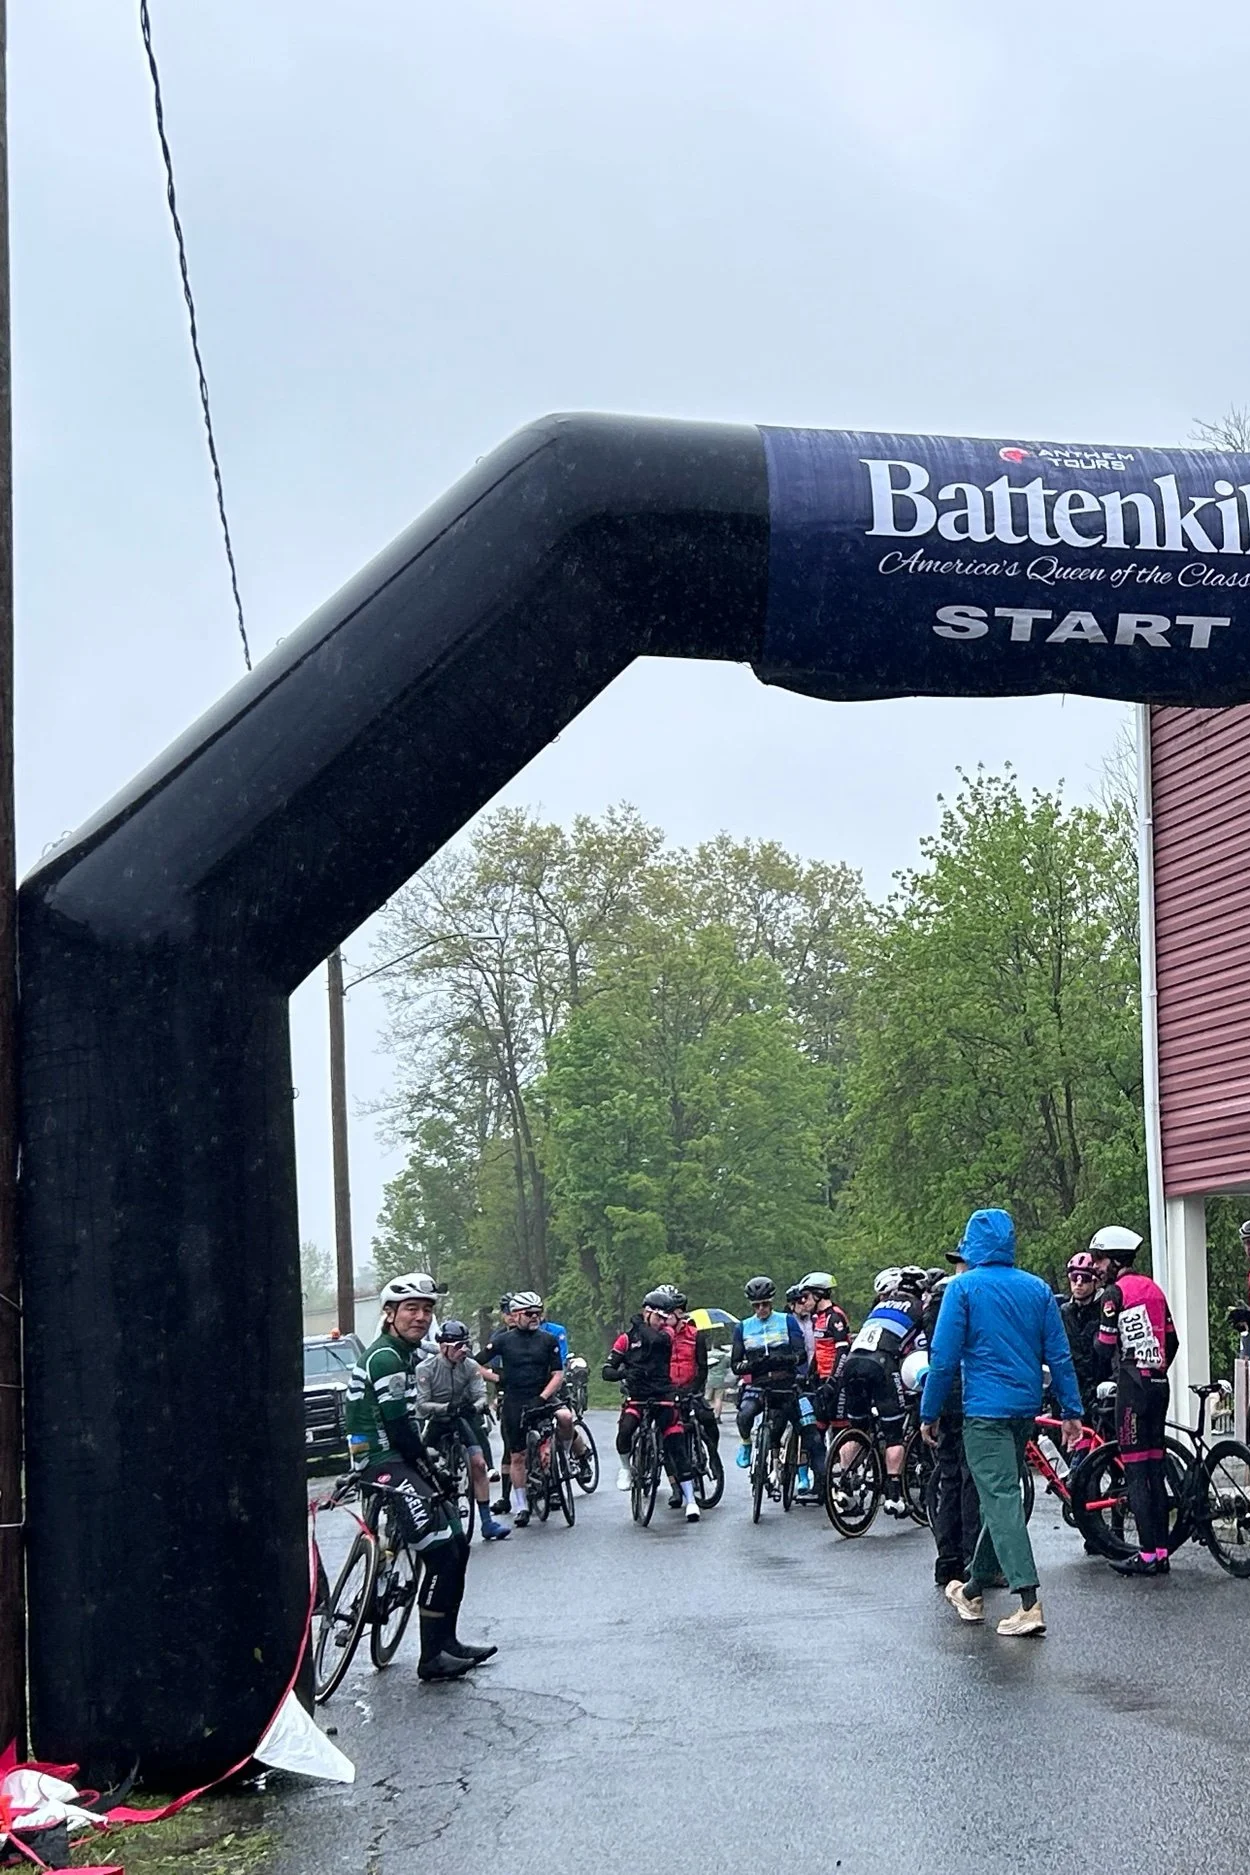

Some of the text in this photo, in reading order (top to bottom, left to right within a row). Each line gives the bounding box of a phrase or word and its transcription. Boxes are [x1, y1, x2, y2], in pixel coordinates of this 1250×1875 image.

[1038, 449, 1135, 462] ANTHEM
[1047, 457, 1126, 471] TOURS
[878, 547, 1022, 577] America's
[1026, 555, 1106, 586] Queen
[1110, 563, 1136, 589] of
[1136, 566, 1173, 586] the
[932, 604, 1231, 649] START
[1121, 1313, 1146, 1342] 399
